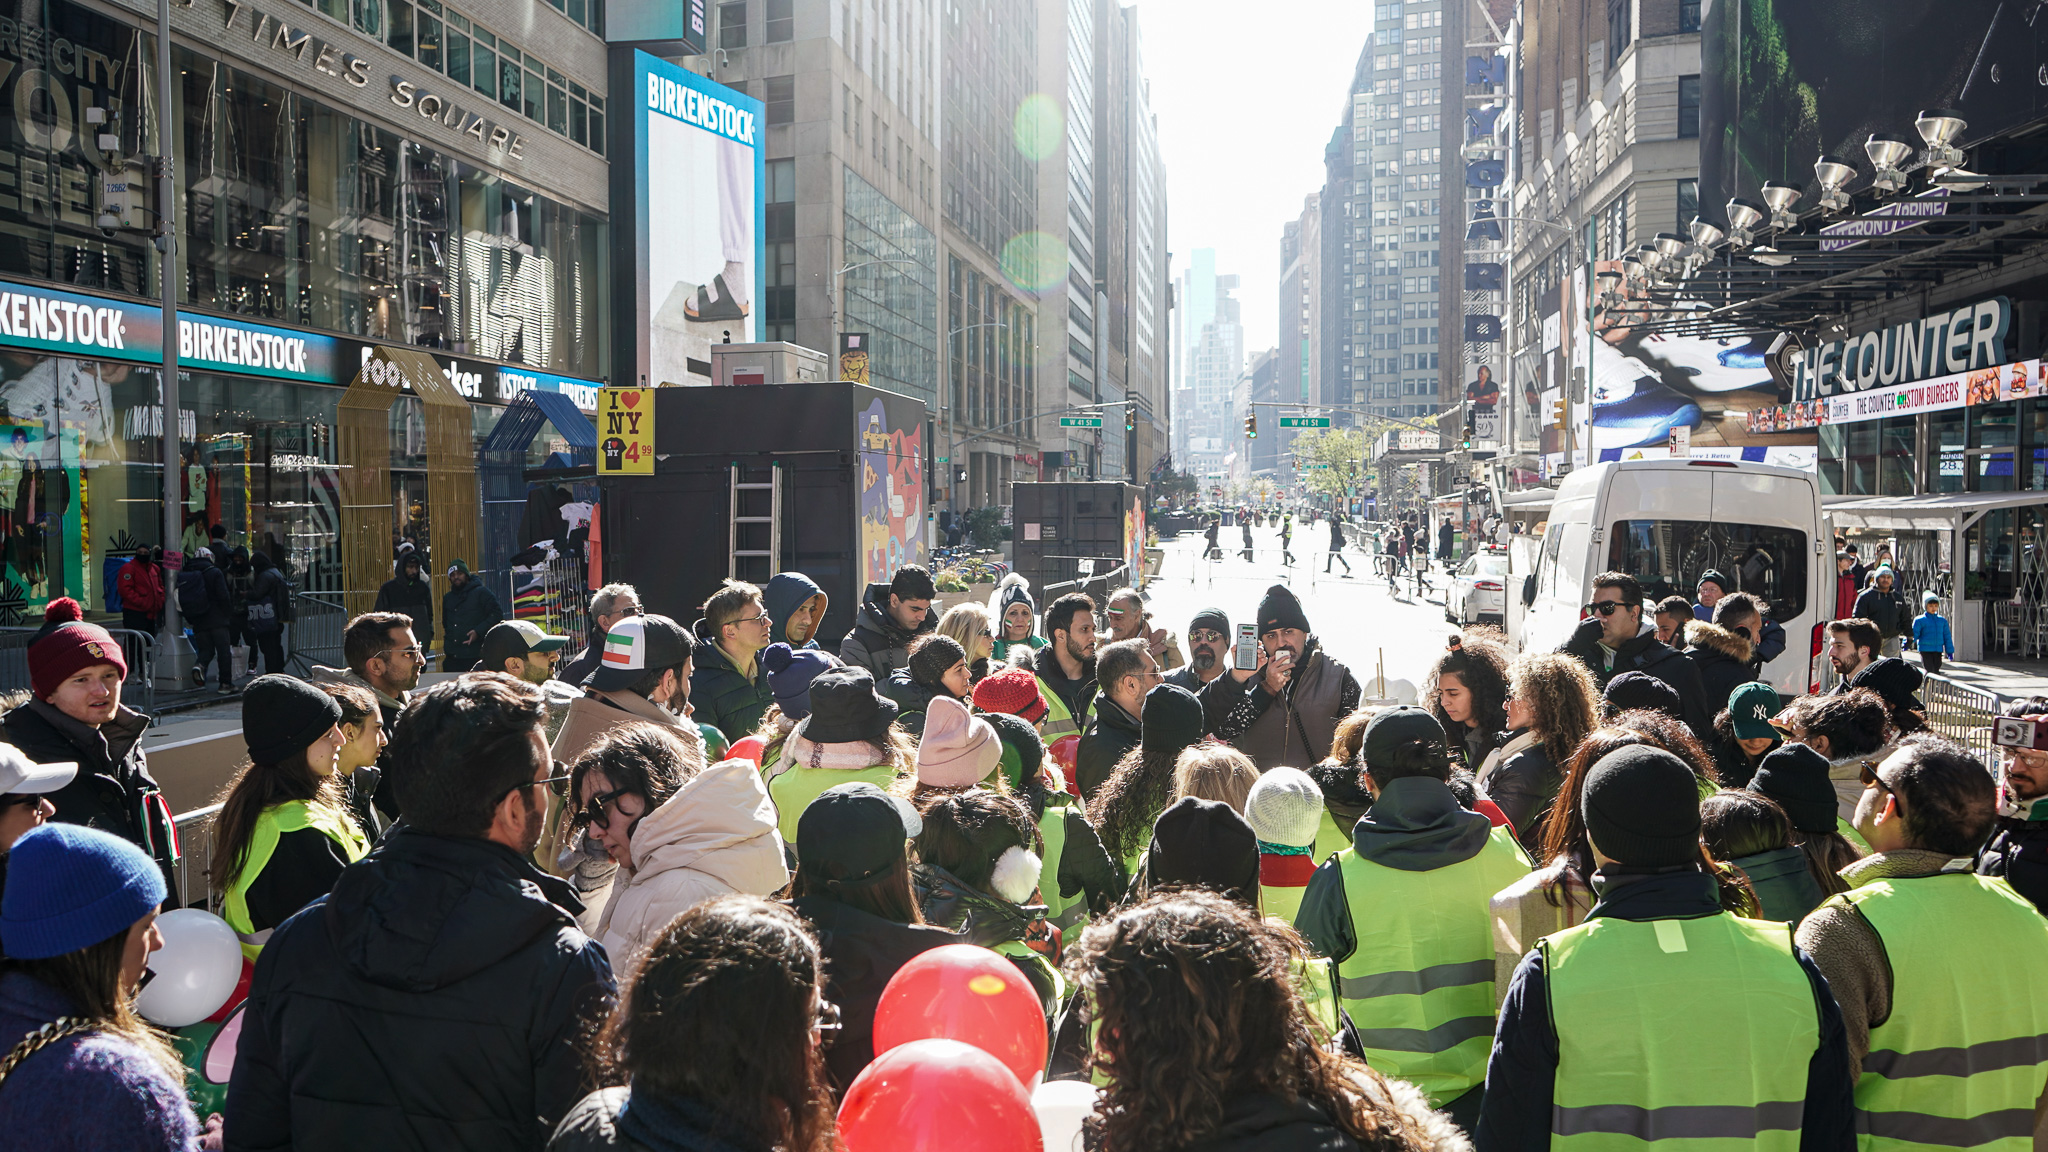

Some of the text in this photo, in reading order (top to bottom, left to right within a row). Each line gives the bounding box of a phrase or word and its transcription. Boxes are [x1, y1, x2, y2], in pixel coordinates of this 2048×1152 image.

[53, 37, 121, 90] CITY
[222, 0, 530, 161] TIMES SQUARE
[0, 58, 122, 172] OU
[106, 183, 127, 193] 72662
[1822, 200, 1945, 250] OUTFRONT PRIME
[1790, 298, 2002, 402] THE COUNTER
[1857, 397, 1867, 415] THE
[1898, 389, 1925, 410] CUSTOM
[1926, 381, 1959, 405] BURGERS
[607, 411, 643, 435] NY
[1300, 419, 1309, 427] 41
[1310, 419, 1319, 427] St
[641, 445, 653, 456] 99
[1752, 704, 1767, 720] NY
